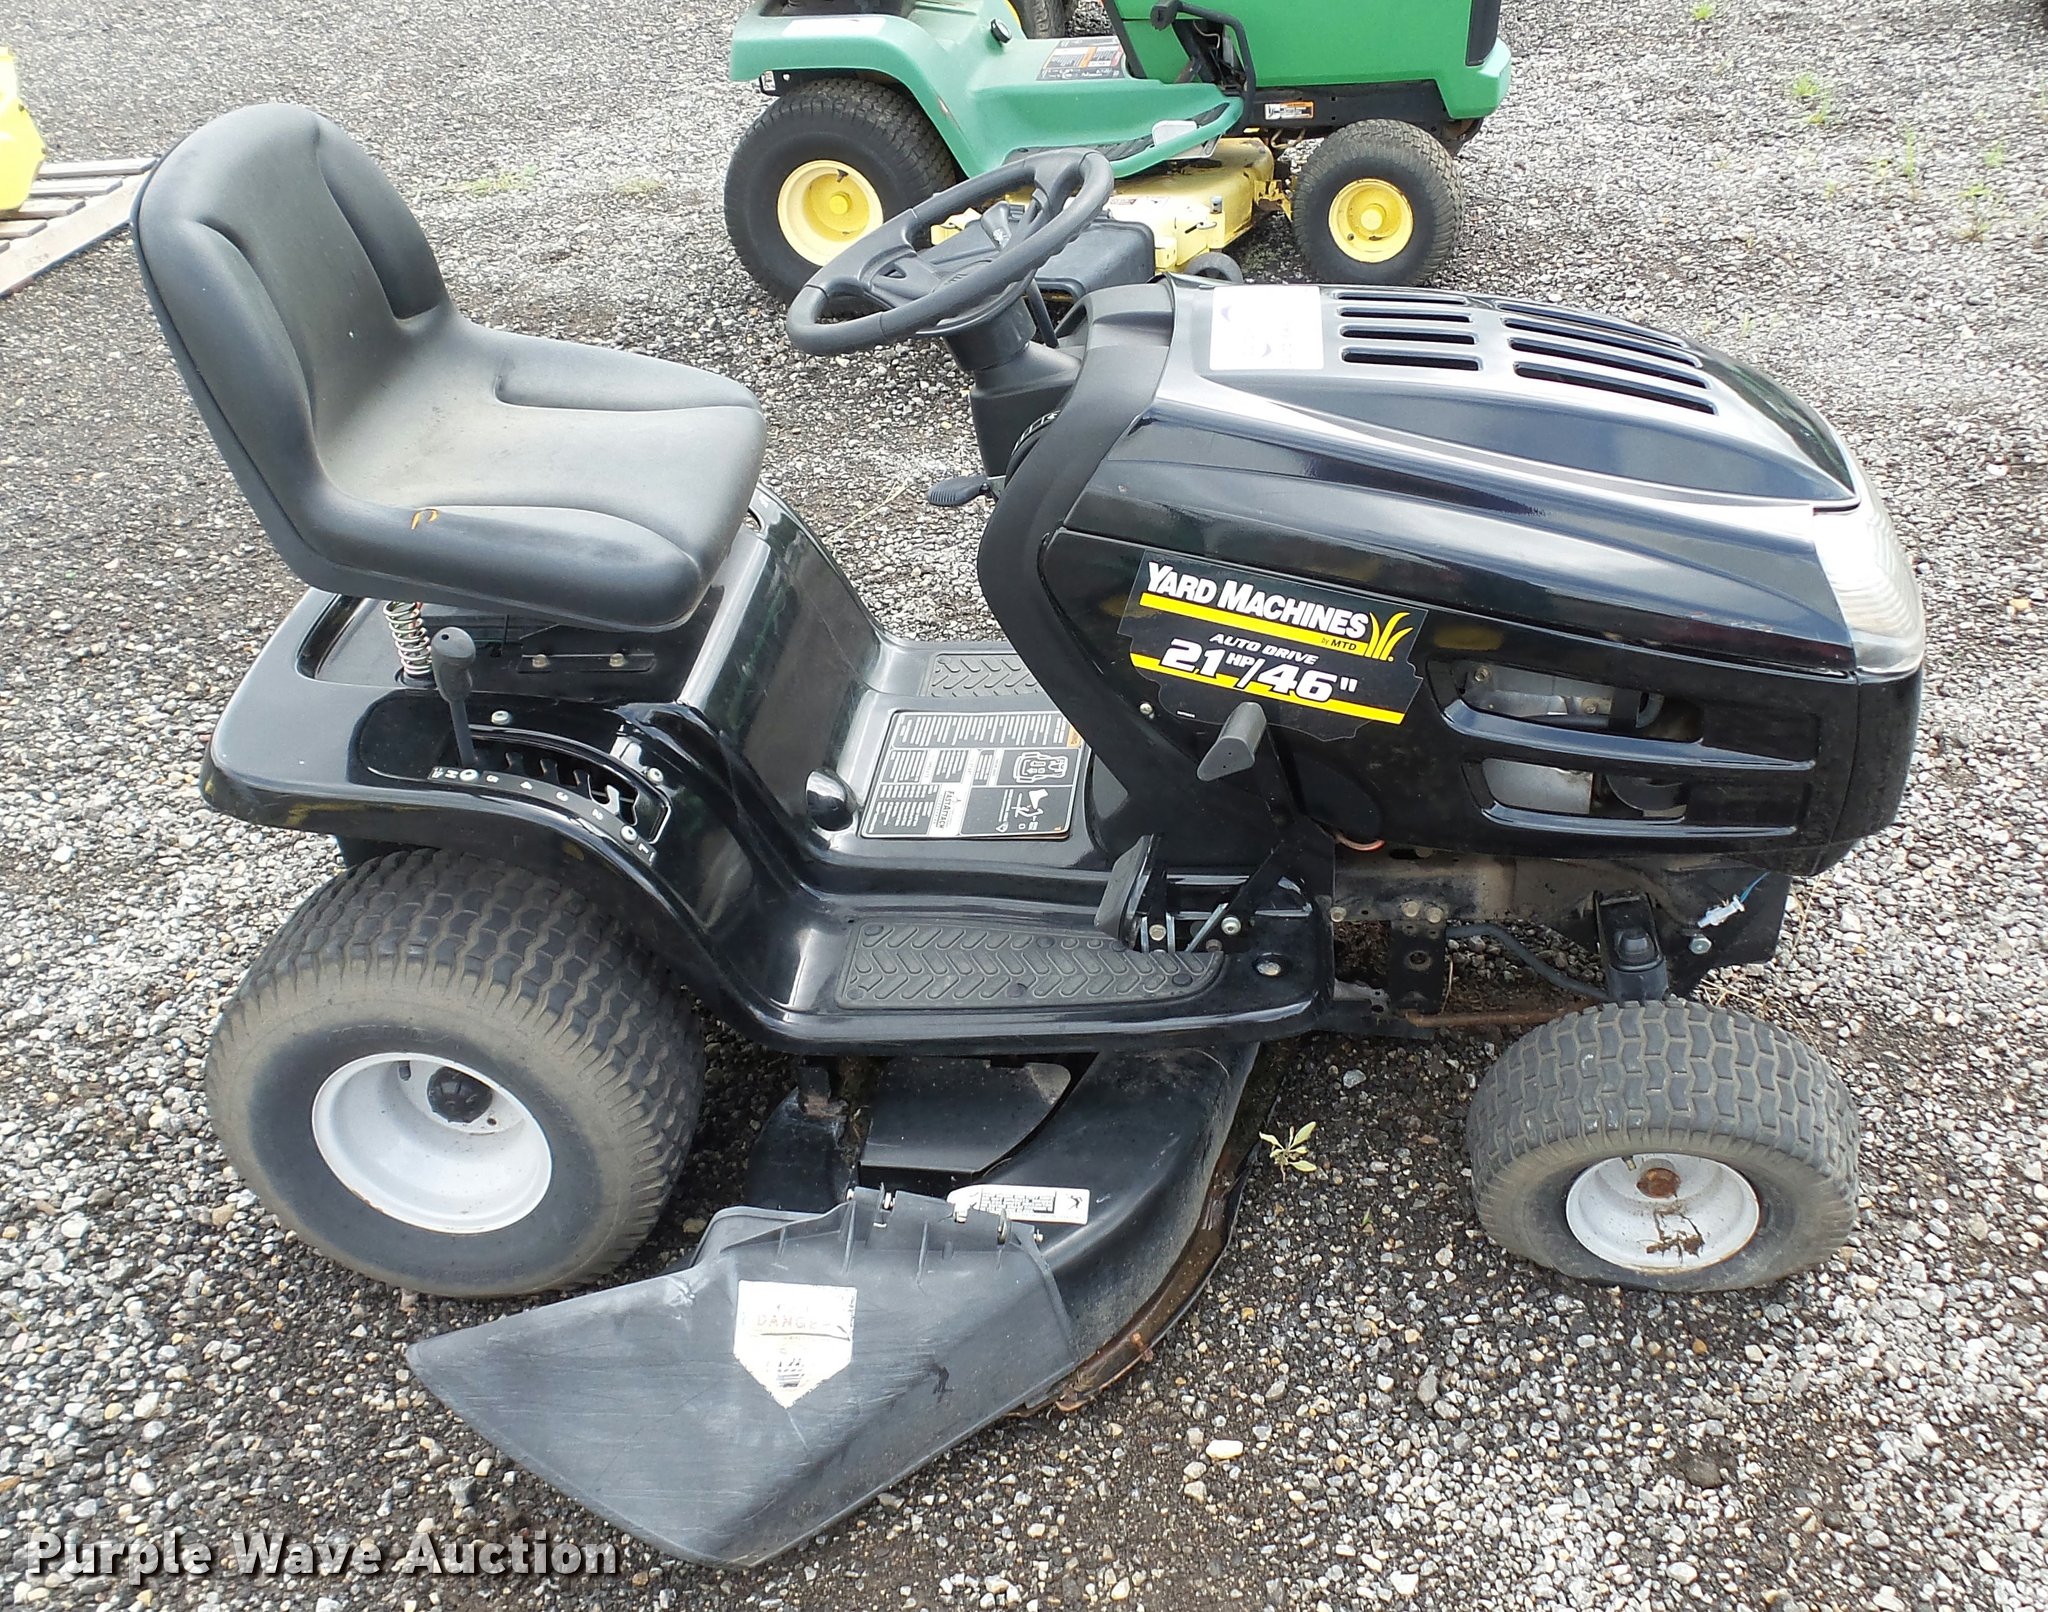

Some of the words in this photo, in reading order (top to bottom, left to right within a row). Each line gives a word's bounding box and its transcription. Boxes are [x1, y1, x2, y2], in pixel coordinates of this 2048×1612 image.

[1147, 562, 1217, 605] YARD
[1219, 581, 1369, 638] MACHINES
[1209, 633, 1262, 654] AUTO
[1262, 644, 1320, 665] DRIVE
[1331, 639, 1357, 652] MTD
